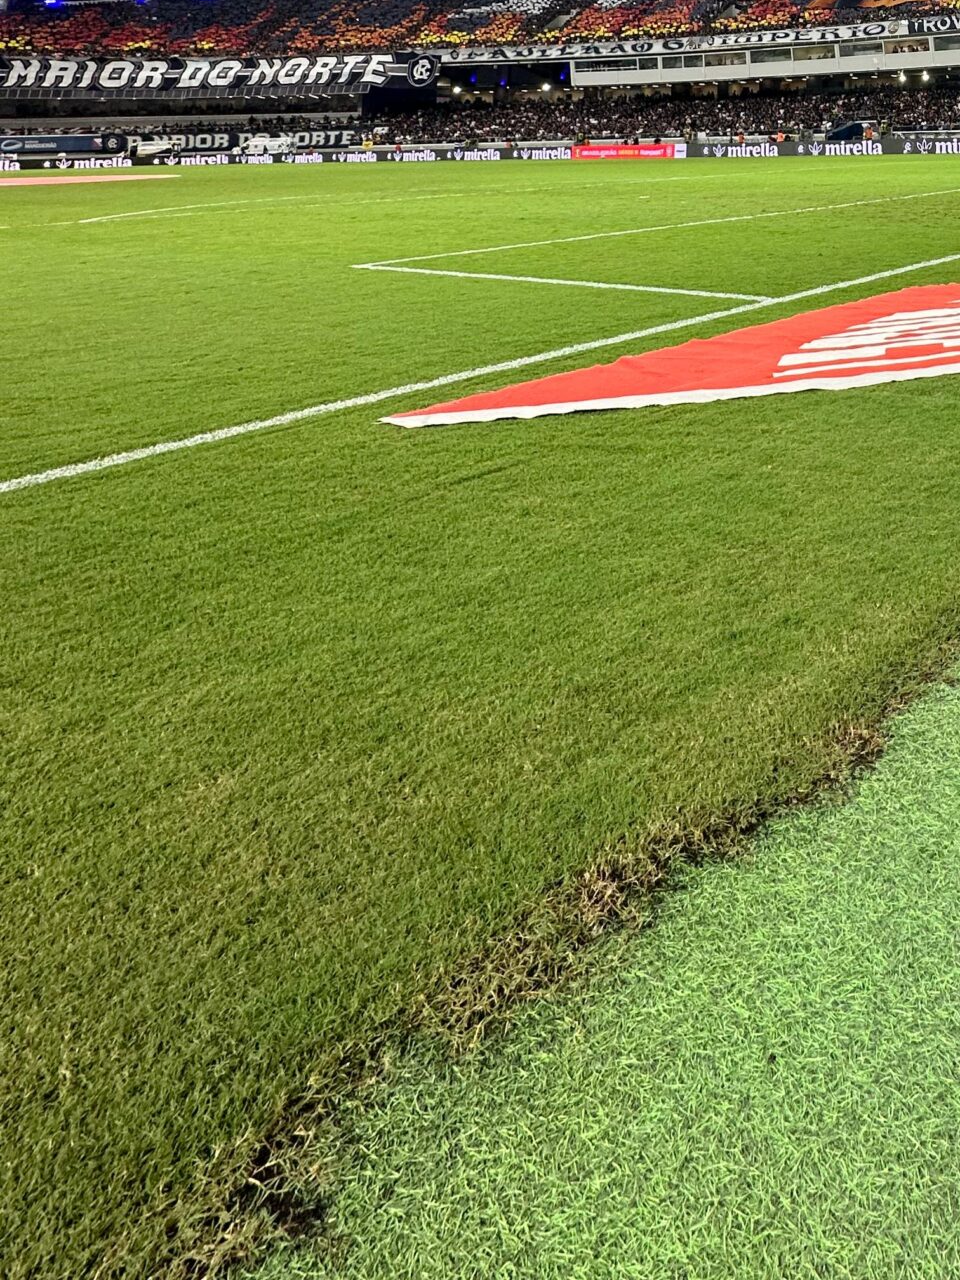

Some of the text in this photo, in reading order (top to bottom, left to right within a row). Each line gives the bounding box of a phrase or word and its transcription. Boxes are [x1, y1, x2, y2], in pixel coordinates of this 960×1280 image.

[3, 54, 394, 88] MAIOR DO NORTE
[464, 148, 500, 160] mirella
[531, 147, 571, 160] mirella
[727, 141, 778, 157] mirella
[825, 140, 883, 155] mirella
[295, 152, 323, 163] mirella
[347, 151, 377, 162] mirella
[403, 149, 435, 161] mirella
[74, 156, 132, 169] mirella
